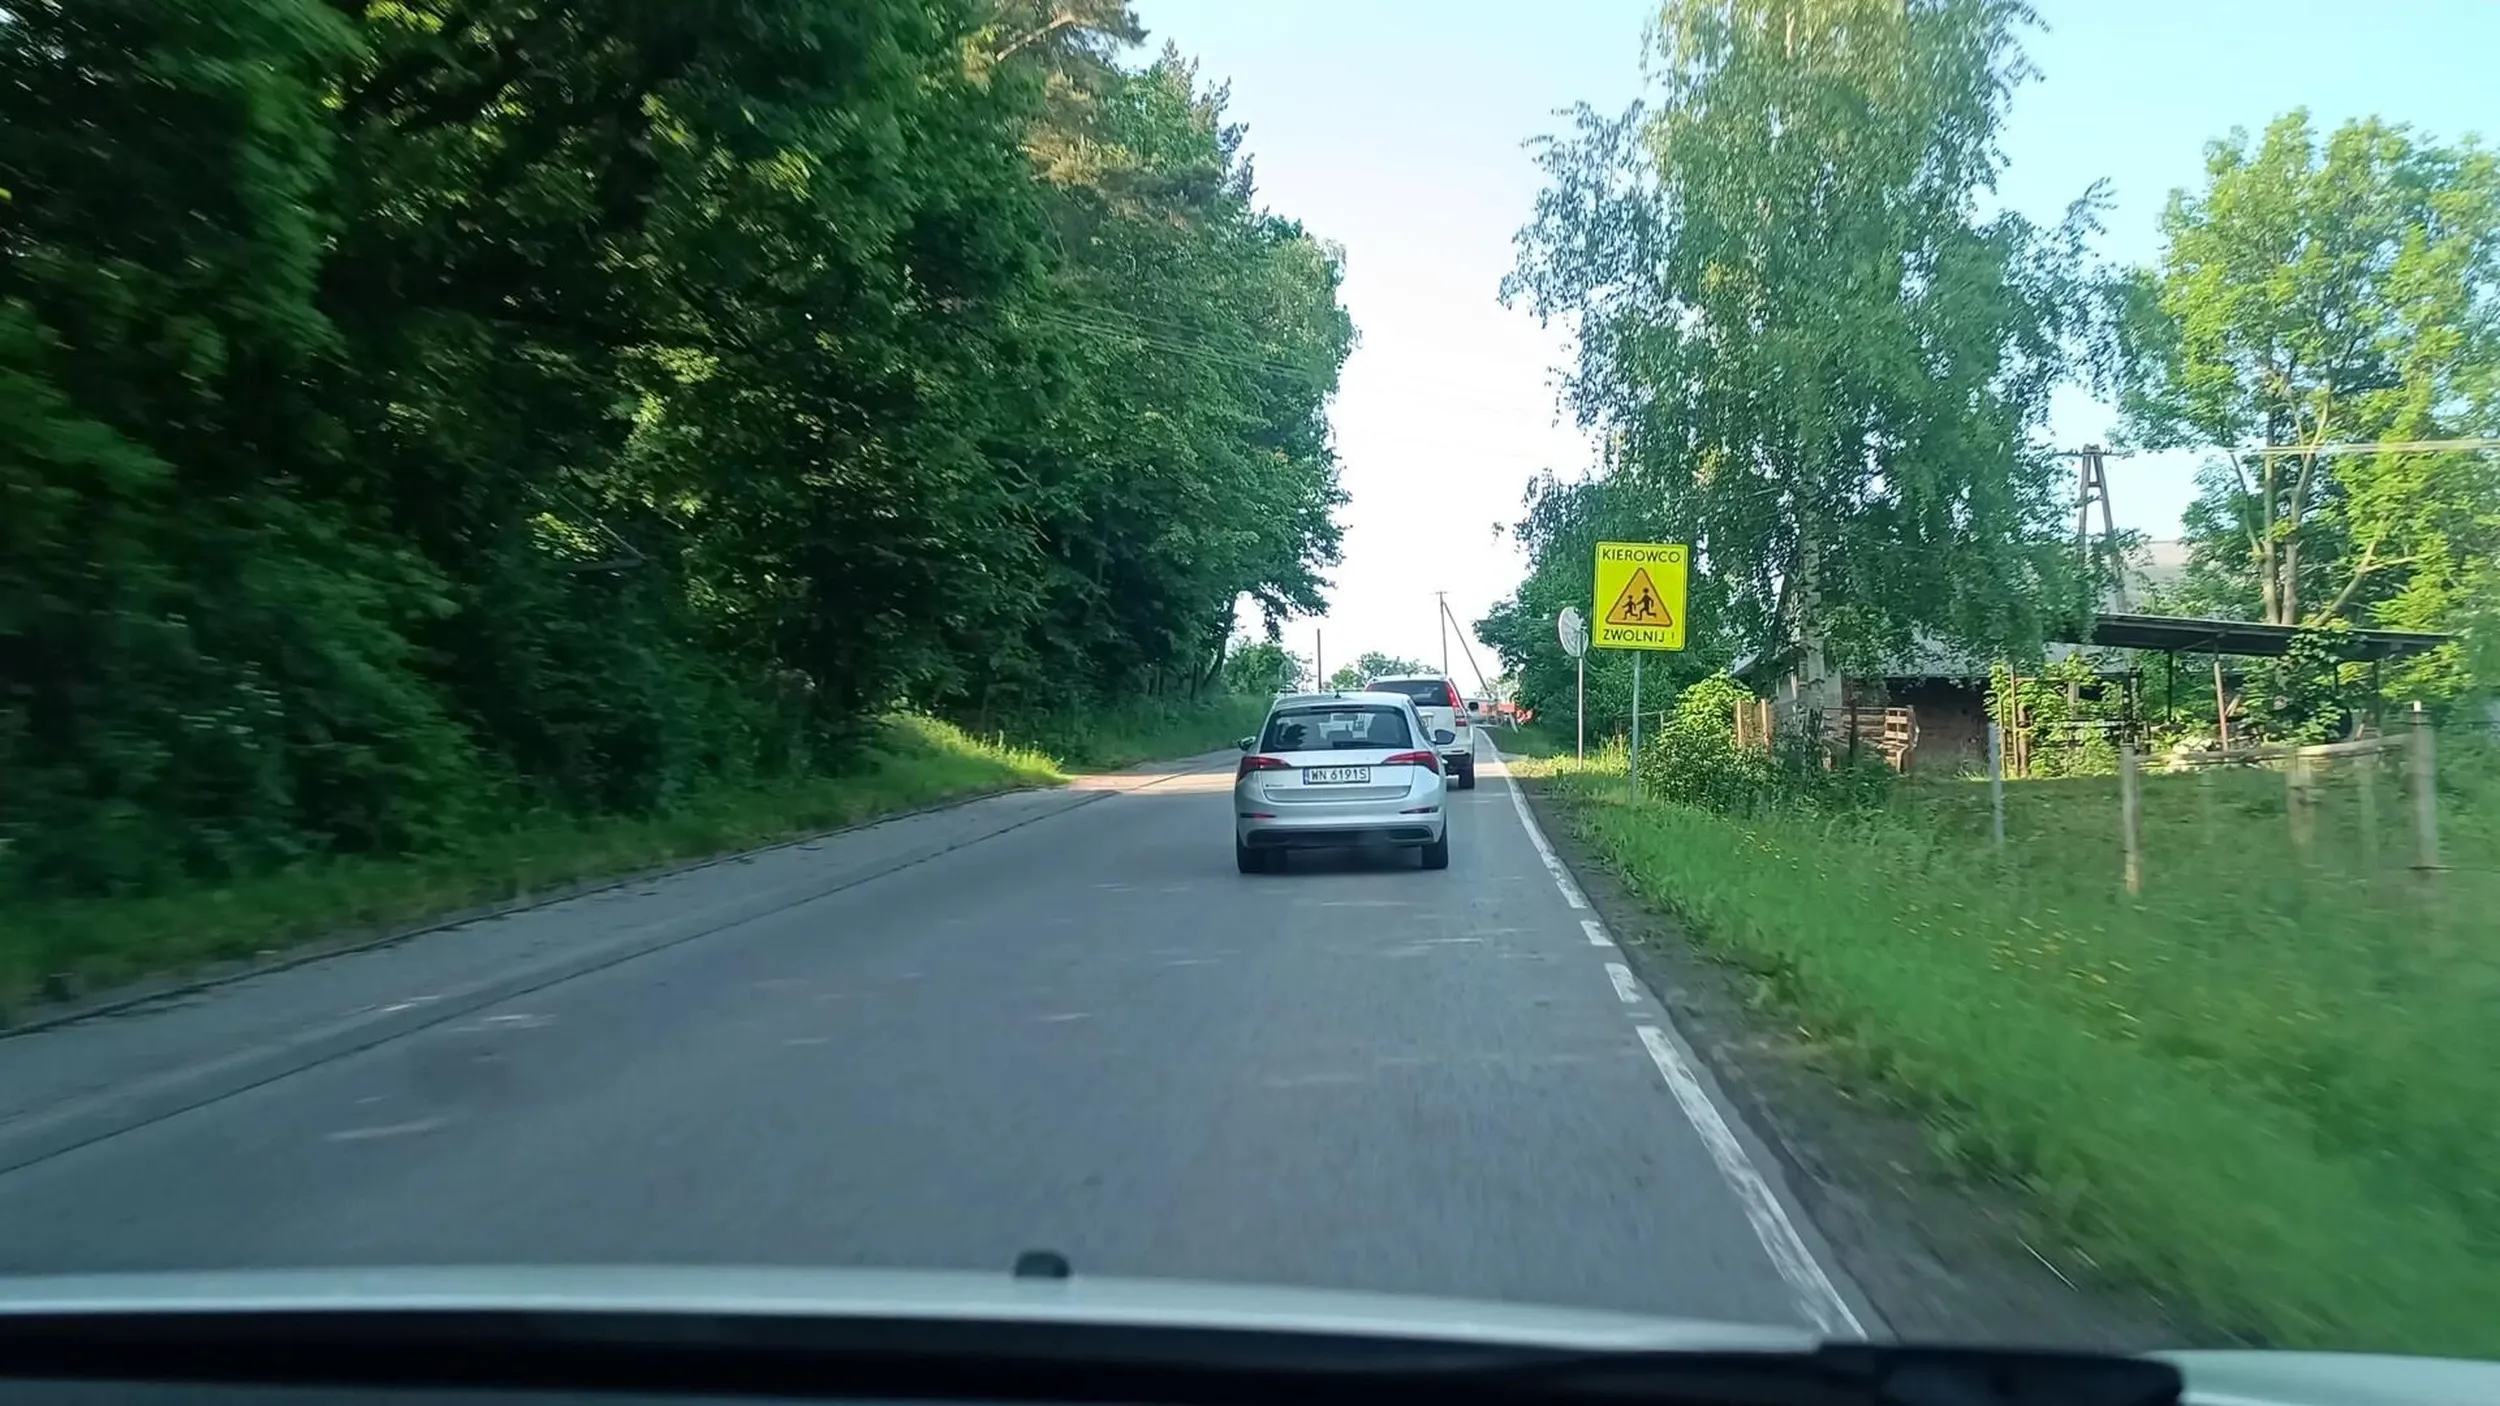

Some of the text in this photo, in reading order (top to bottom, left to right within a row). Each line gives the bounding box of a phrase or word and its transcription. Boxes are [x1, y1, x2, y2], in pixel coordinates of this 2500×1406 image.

[1602, 549, 1681, 563] KIEROWCO
[1603, 629, 1665, 642] ZWOLNIJ
[1311, 768, 1367, 780] WN 6191S
